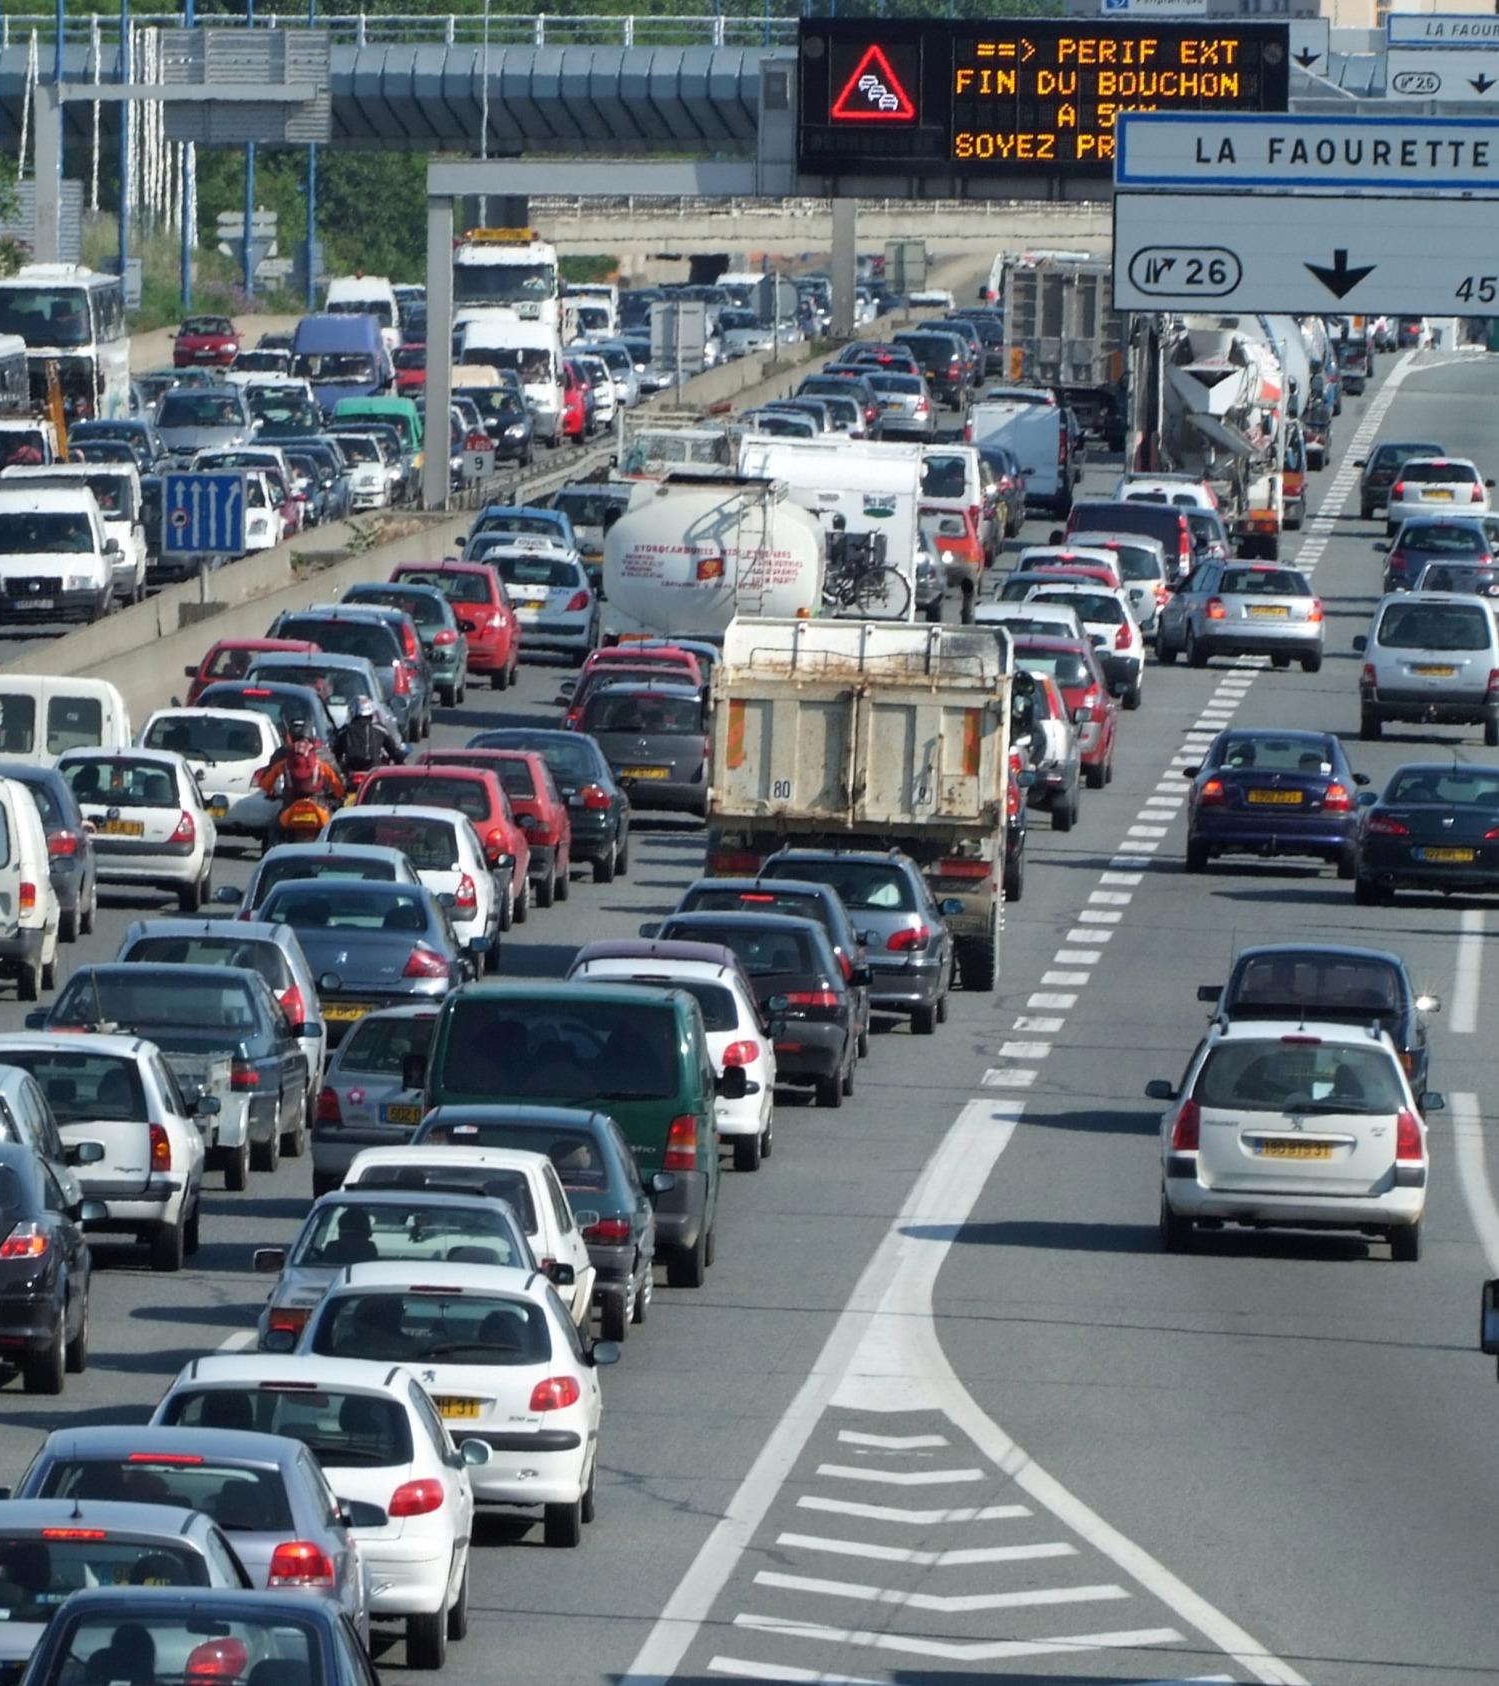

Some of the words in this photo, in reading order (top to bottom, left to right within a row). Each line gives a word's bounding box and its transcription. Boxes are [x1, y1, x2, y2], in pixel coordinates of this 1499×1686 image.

[1425, 22, 1443, 36] LA
[1058, 39, 1157, 64] PERIF
[1180, 41, 1239, 65] EXT
[956, 70, 1016, 95] FIN
[1038, 71, 1077, 95] DU
[1098, 71, 1239, 97] BOUCHON
[1058, 103, 1076, 128] A
[955, 133, 1055, 158] SOYEZ
[1196, 137, 1236, 164] LA
[1268, 138, 1490, 167] FAOURETTE
[1185, 258, 1227, 286] 26
[474, 456, 484, 470] 9
[773, 779, 791, 799] 80
[456, 1400, 474, 1415] 31
